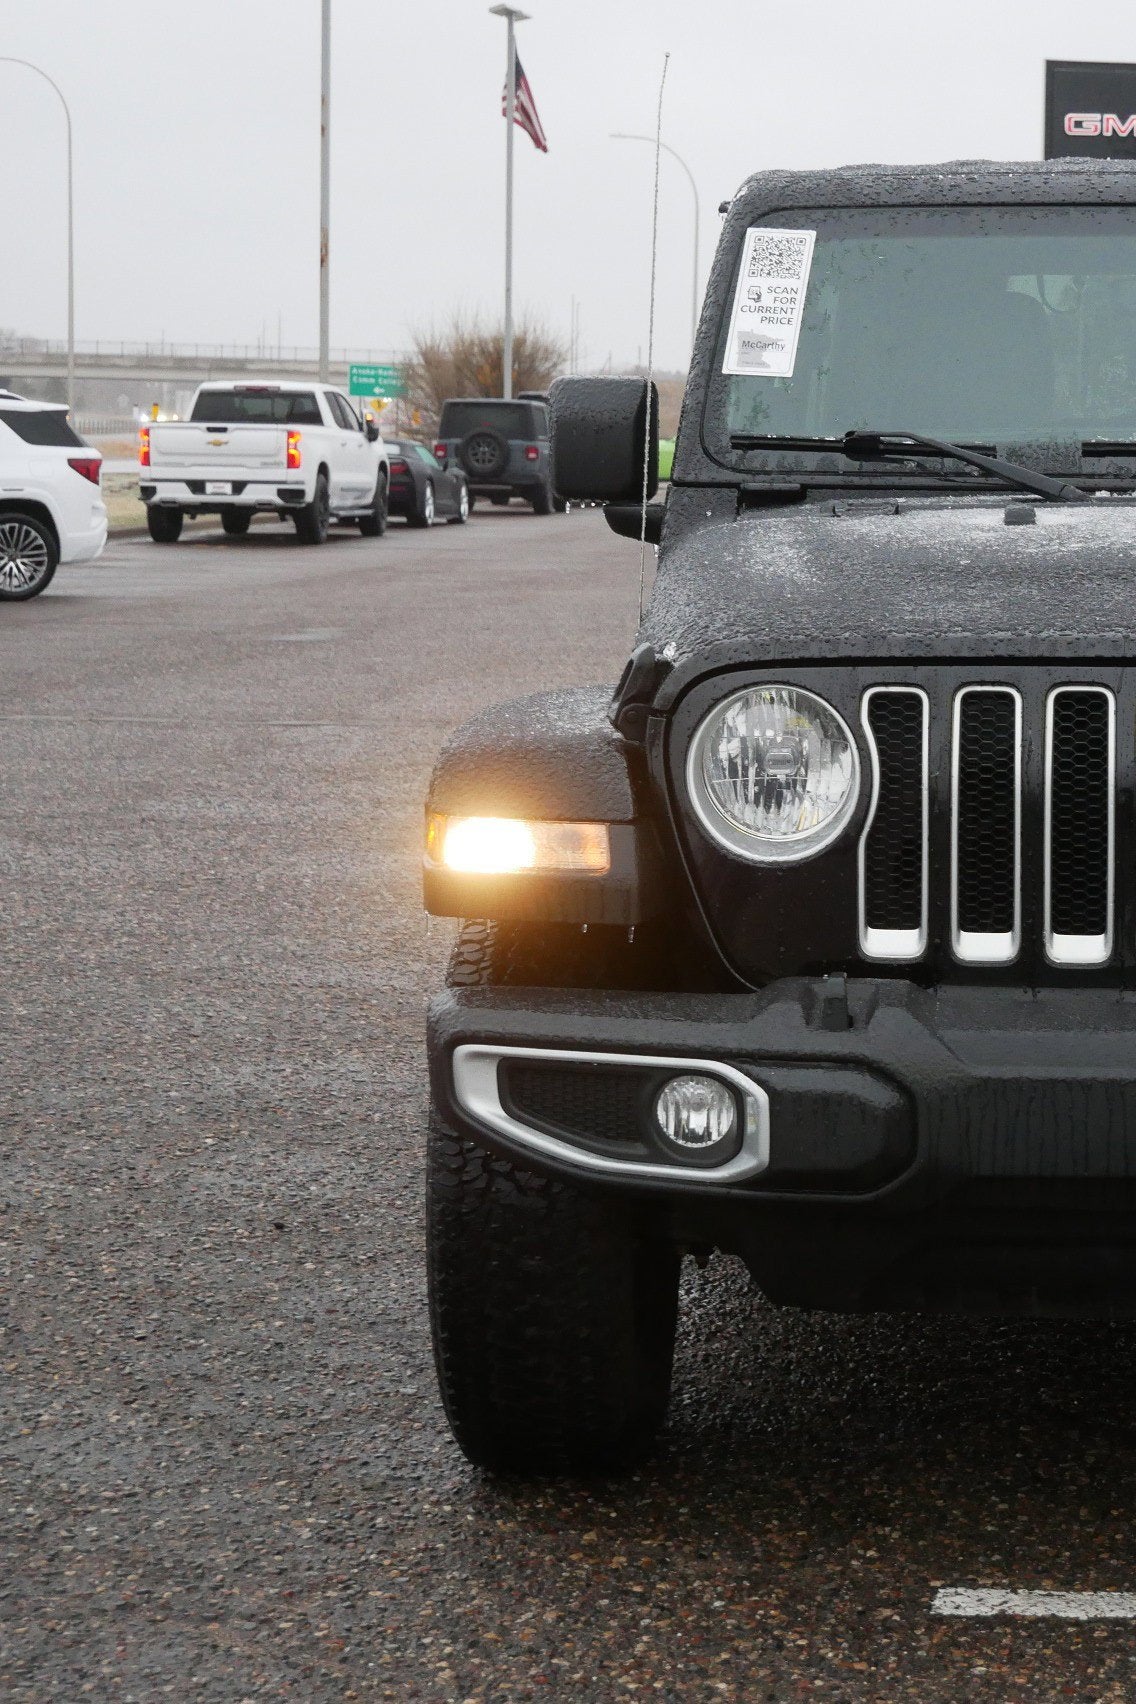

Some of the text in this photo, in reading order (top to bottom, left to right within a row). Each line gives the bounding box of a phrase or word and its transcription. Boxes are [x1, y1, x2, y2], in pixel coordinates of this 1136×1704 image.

[767, 286, 799, 295] SCAN
[773, 296, 797, 305] FOR
[740, 304, 796, 315] CURRENT
[760, 316, 794, 326] PRICE
[741, 340, 786, 351] McCarthy
